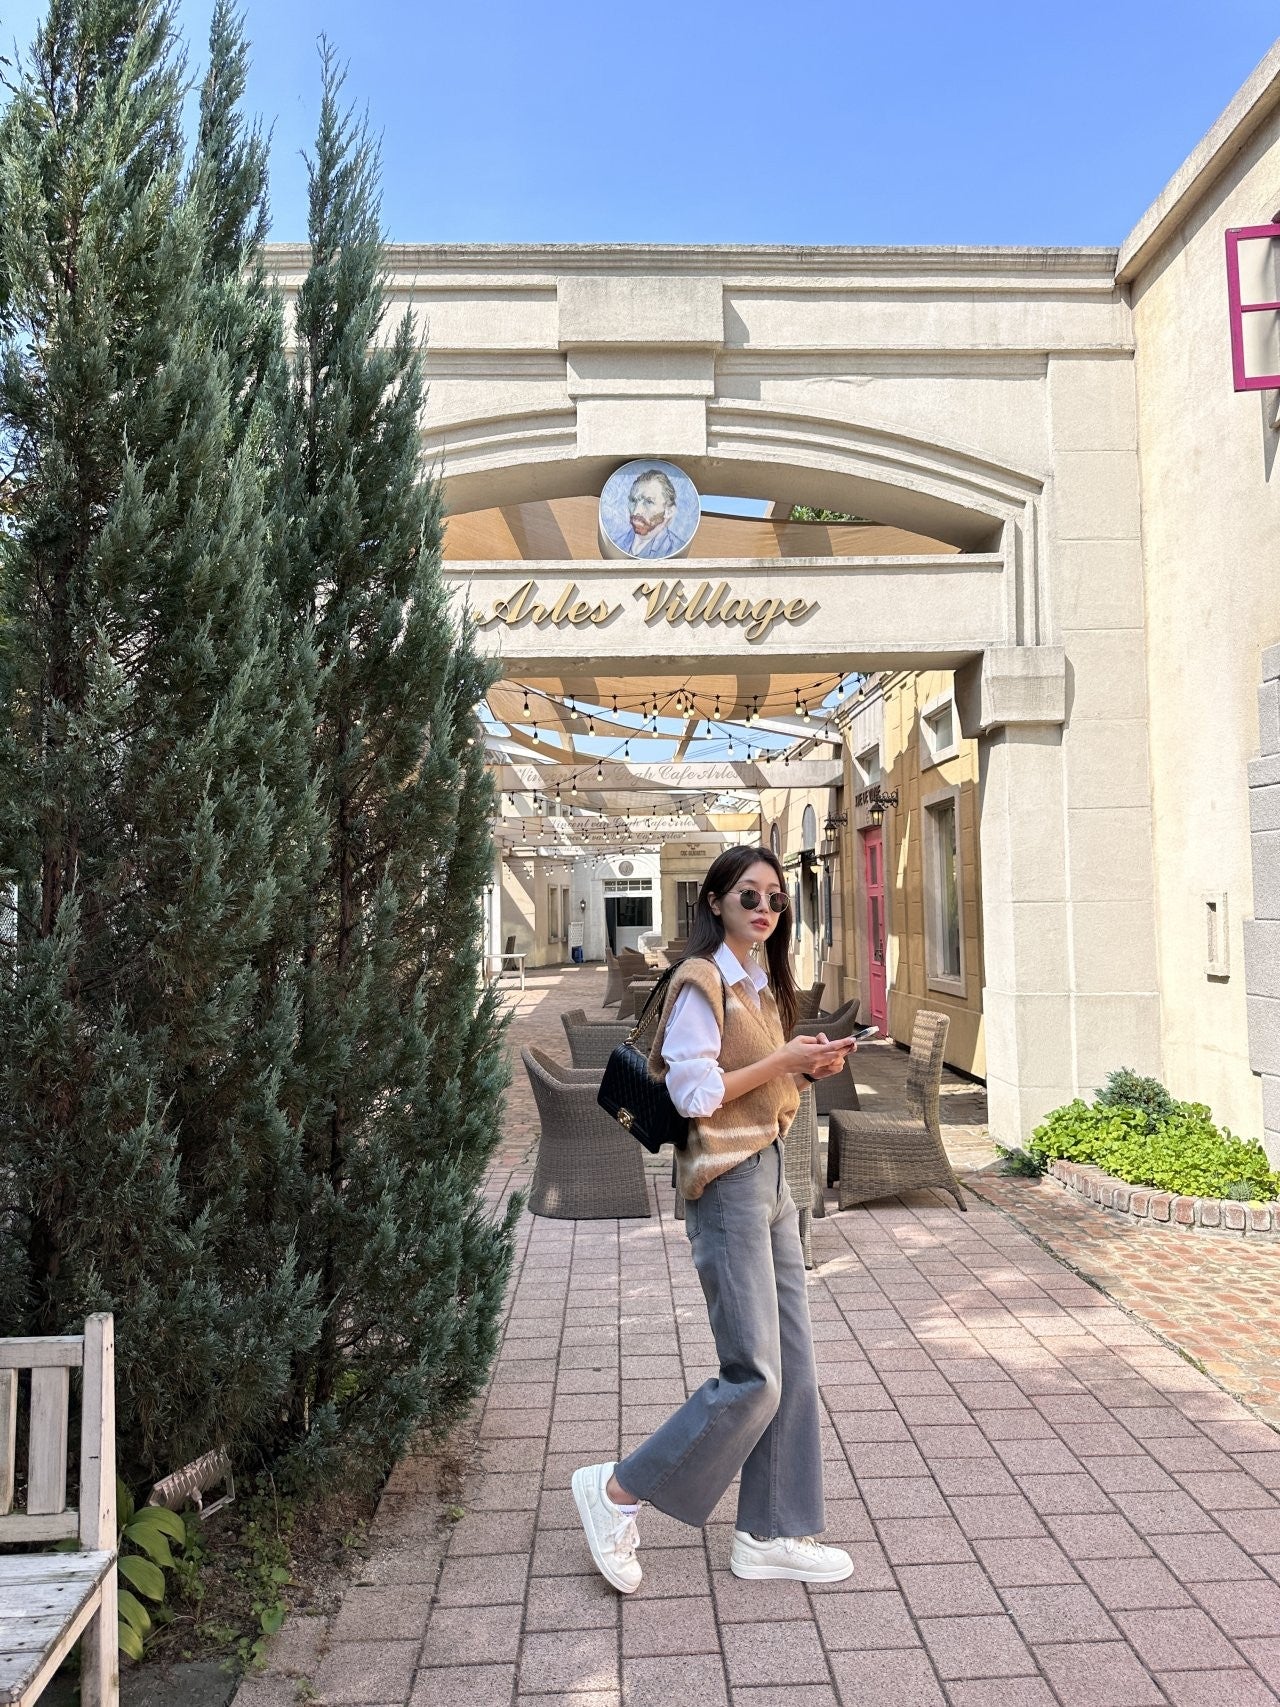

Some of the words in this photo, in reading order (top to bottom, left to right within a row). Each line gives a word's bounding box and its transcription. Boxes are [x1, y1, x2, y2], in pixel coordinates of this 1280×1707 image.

[471, 579, 623, 625] Arles
[632, 579, 818, 641] Village
[658, 765, 696, 786] Cafe
[697, 764, 738, 780] Arles
